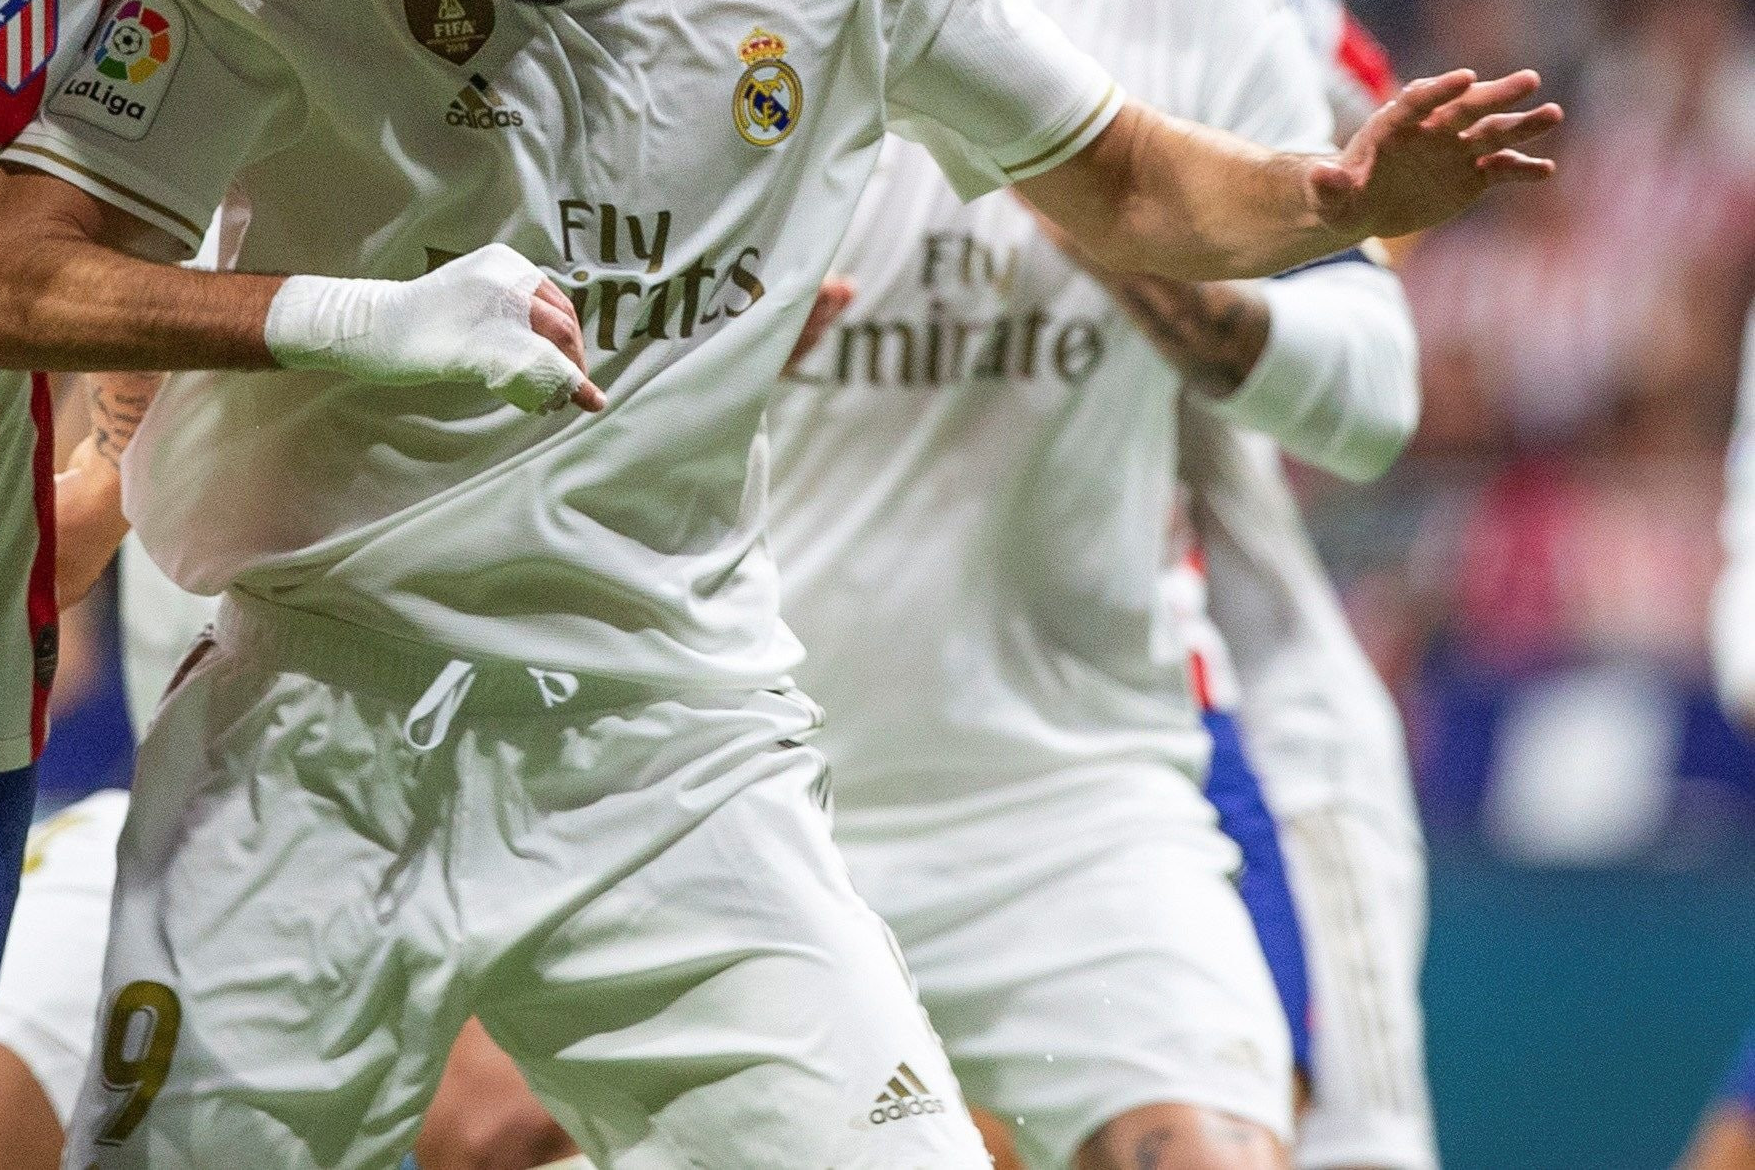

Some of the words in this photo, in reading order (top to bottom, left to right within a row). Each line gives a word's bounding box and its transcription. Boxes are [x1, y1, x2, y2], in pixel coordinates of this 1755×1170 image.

[433, 20, 475, 37] FIFA
[63, 78, 147, 120] LaLiga
[558, 199, 671, 274] Fly
[426, 244, 766, 351] irats
[787, 299, 1105, 388] mirate
[95, 980, 182, 1147] 9
